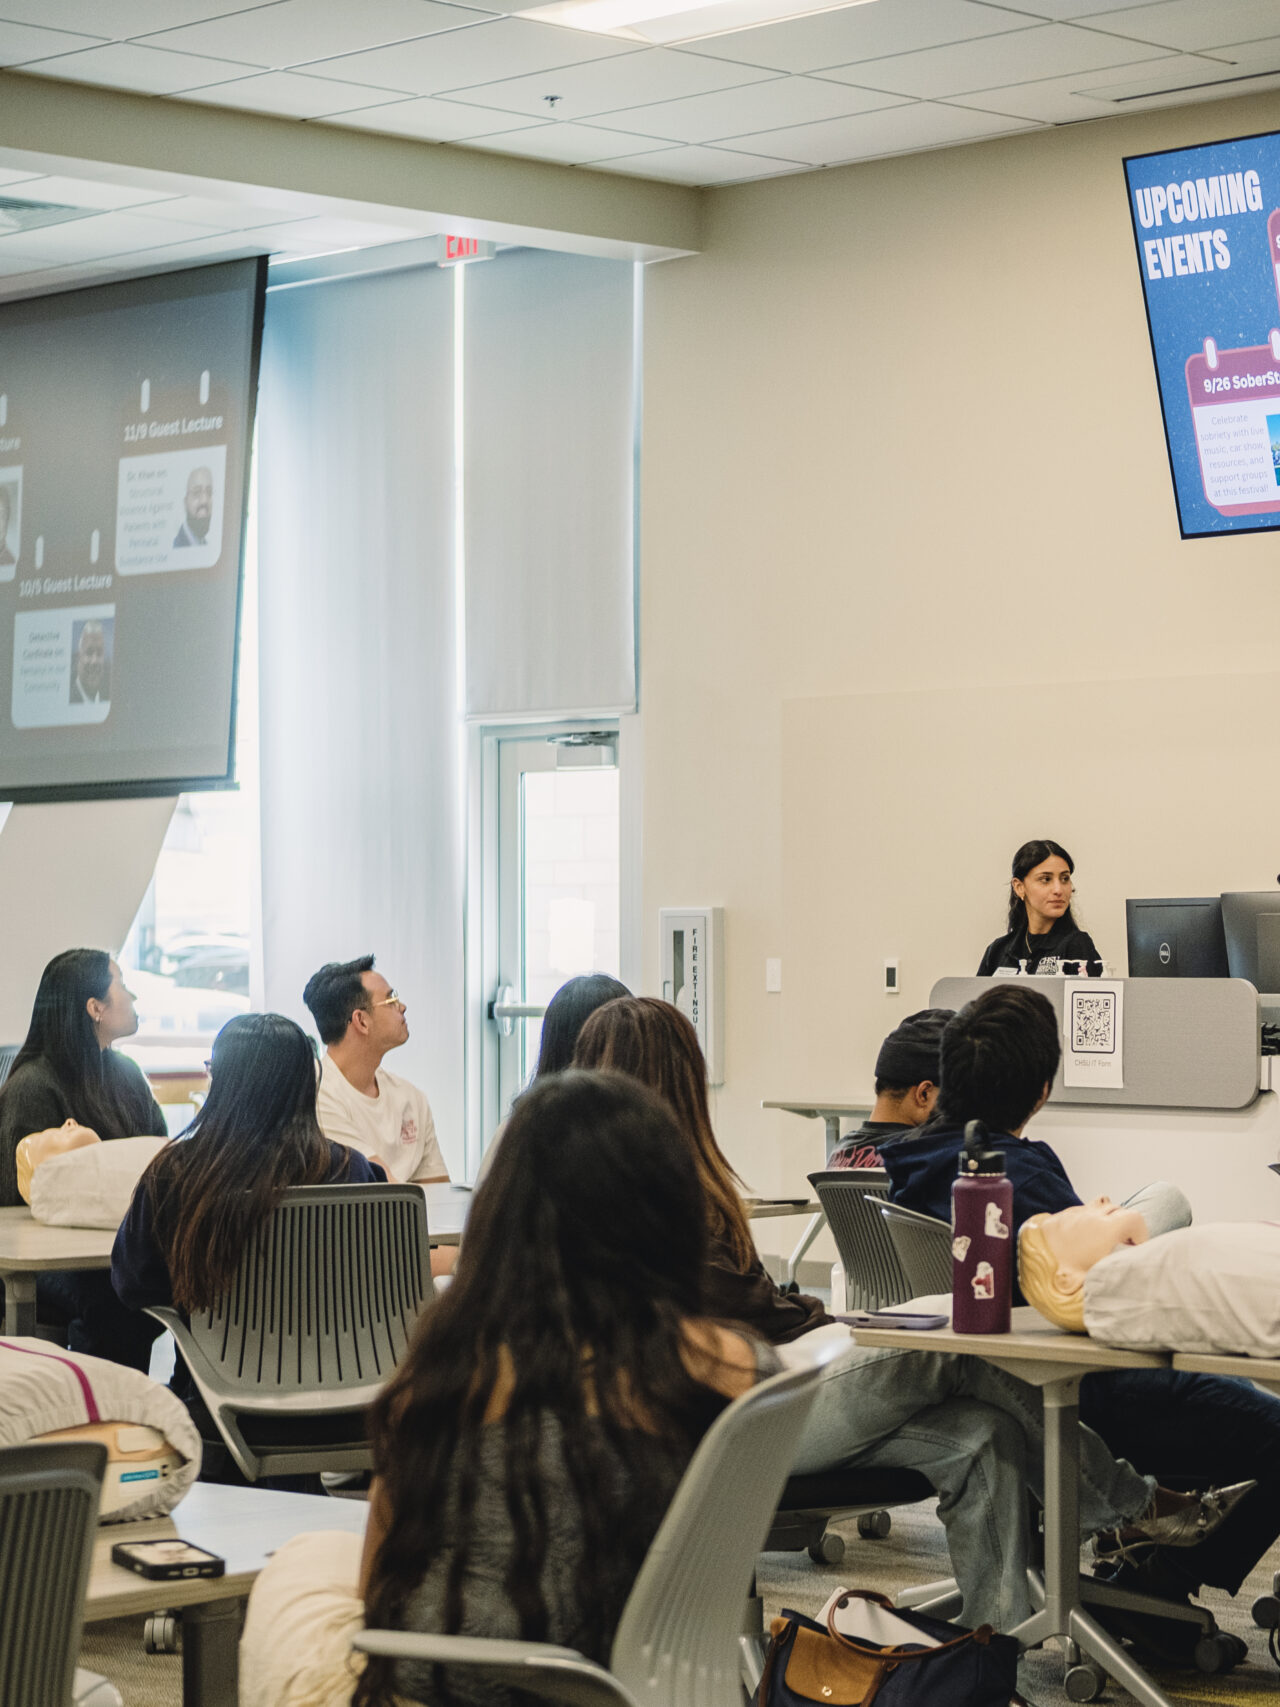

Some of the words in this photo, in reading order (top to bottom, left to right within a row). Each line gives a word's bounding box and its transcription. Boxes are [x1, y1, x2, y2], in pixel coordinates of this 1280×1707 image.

[1135, 170, 1263, 228] UPCOMING
[1144, 229, 1231, 280] EVENTS
[1203, 376, 1231, 394] 9/26
[148, 418, 180, 438] Guest
[181, 415, 224, 434] Lecture
[1211, 414, 1248, 425] Celebrate
[1200, 430, 1231, 442] sobriety
[1233, 428, 1249, 438] with
[1250, 426, 1264, 436] live
[1204, 444, 1229, 455] music,
[1229, 444, 1242, 453] car
[1243, 441, 1266, 451] show,
[1209, 457, 1249, 469] resources,
[1250, 456, 1264, 465] and
[1210, 472, 1242, 484] support
[1243, 470, 1268, 482] groups
[1222, 486, 1237, 496] this
[73, 573, 112, 591] Lecture
